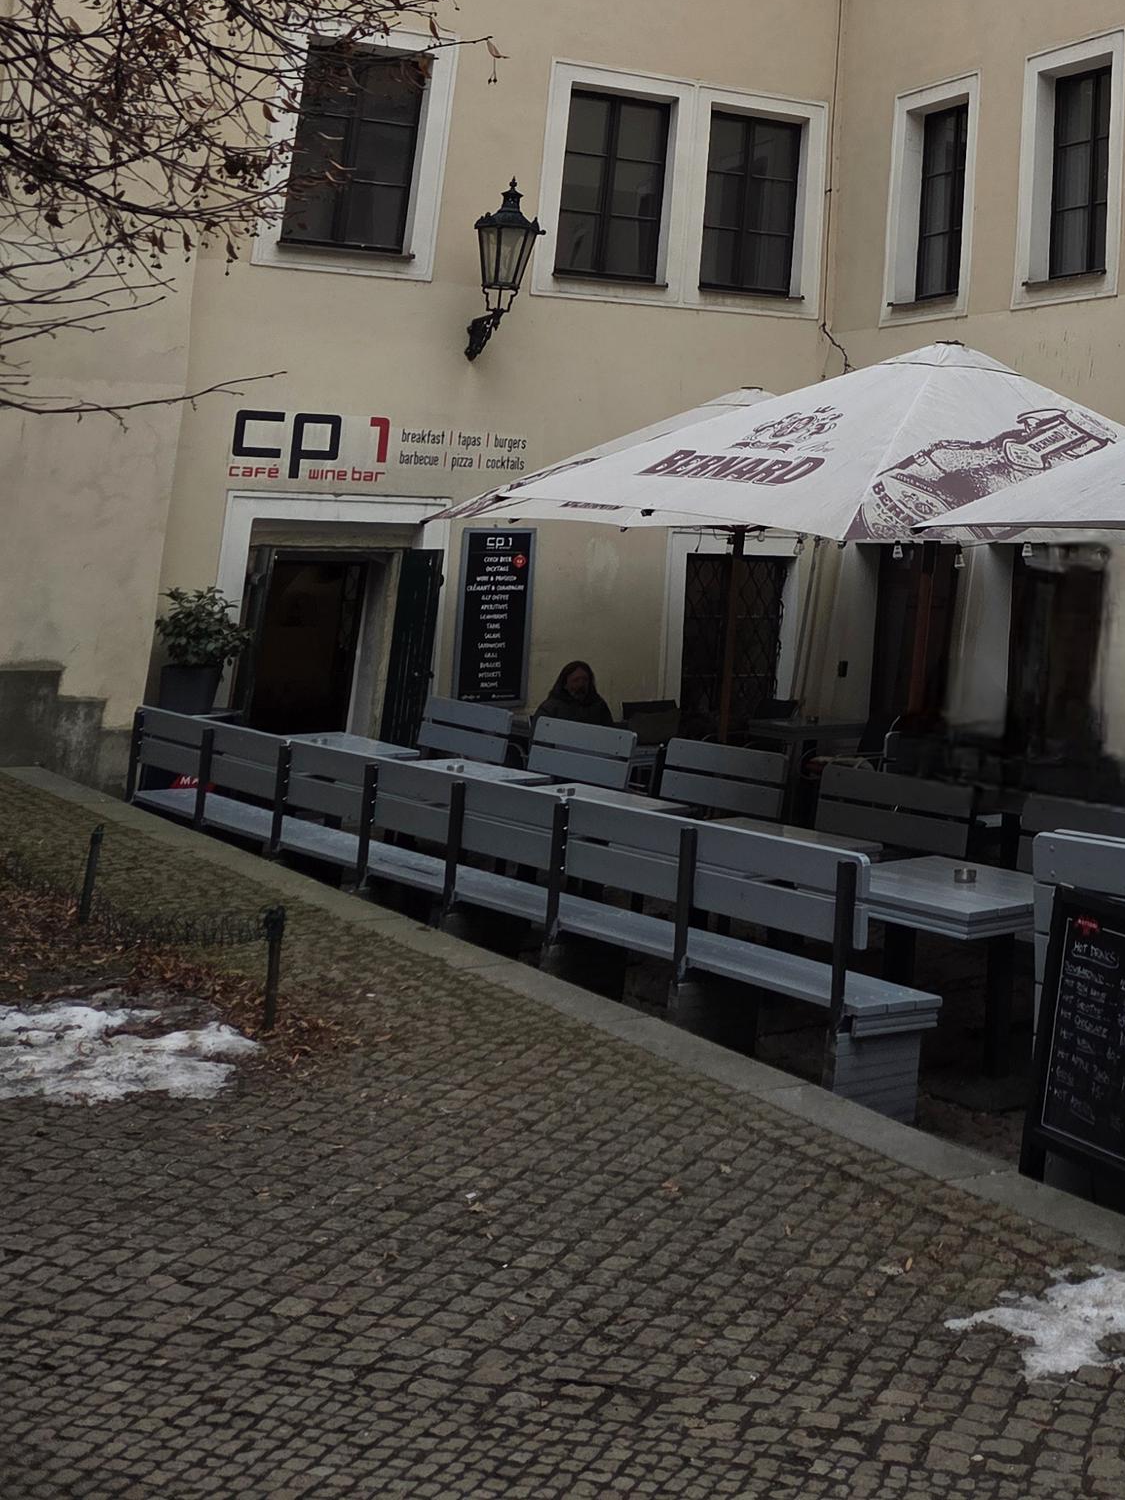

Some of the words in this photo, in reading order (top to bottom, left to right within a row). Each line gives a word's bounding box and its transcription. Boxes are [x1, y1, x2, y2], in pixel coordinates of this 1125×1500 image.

[401, 428, 445, 445] breakfast
[458, 432, 482, 449] tapas
[494, 434, 527, 453] burgers
[1027, 431, 1066, 453] BERNARD
[399, 453, 440, 467] barbecue
[451, 456, 474, 471] pizza
[486, 455, 525, 471] cocktails
[634, 450, 825, 486] BERNARD
[309, 468, 348, 481] wine
[352, 466, 386, 482] bar
